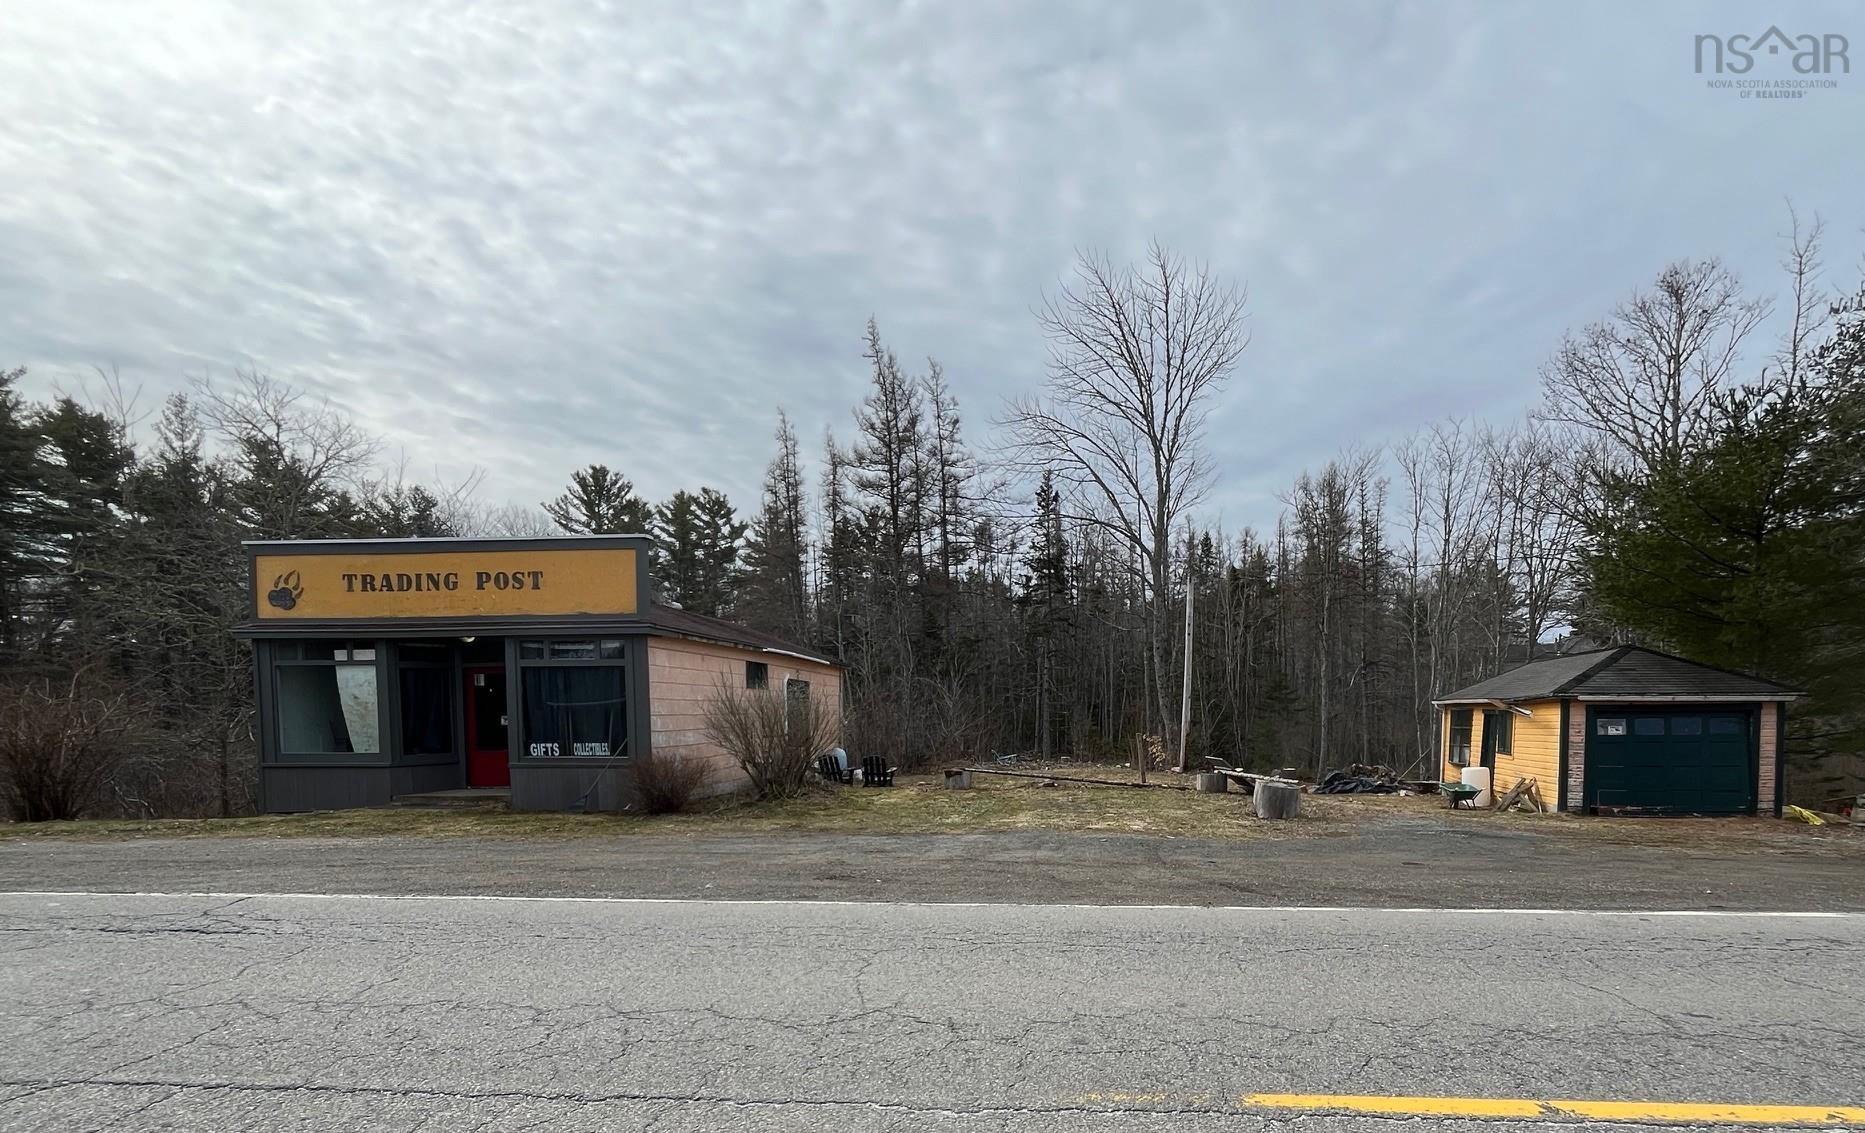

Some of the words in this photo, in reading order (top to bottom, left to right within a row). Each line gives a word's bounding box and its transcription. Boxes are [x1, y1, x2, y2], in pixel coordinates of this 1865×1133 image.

[342, 572, 459, 592] TRADING
[476, 571, 544, 590] POST
[529, 743, 560, 756] GIFTS
